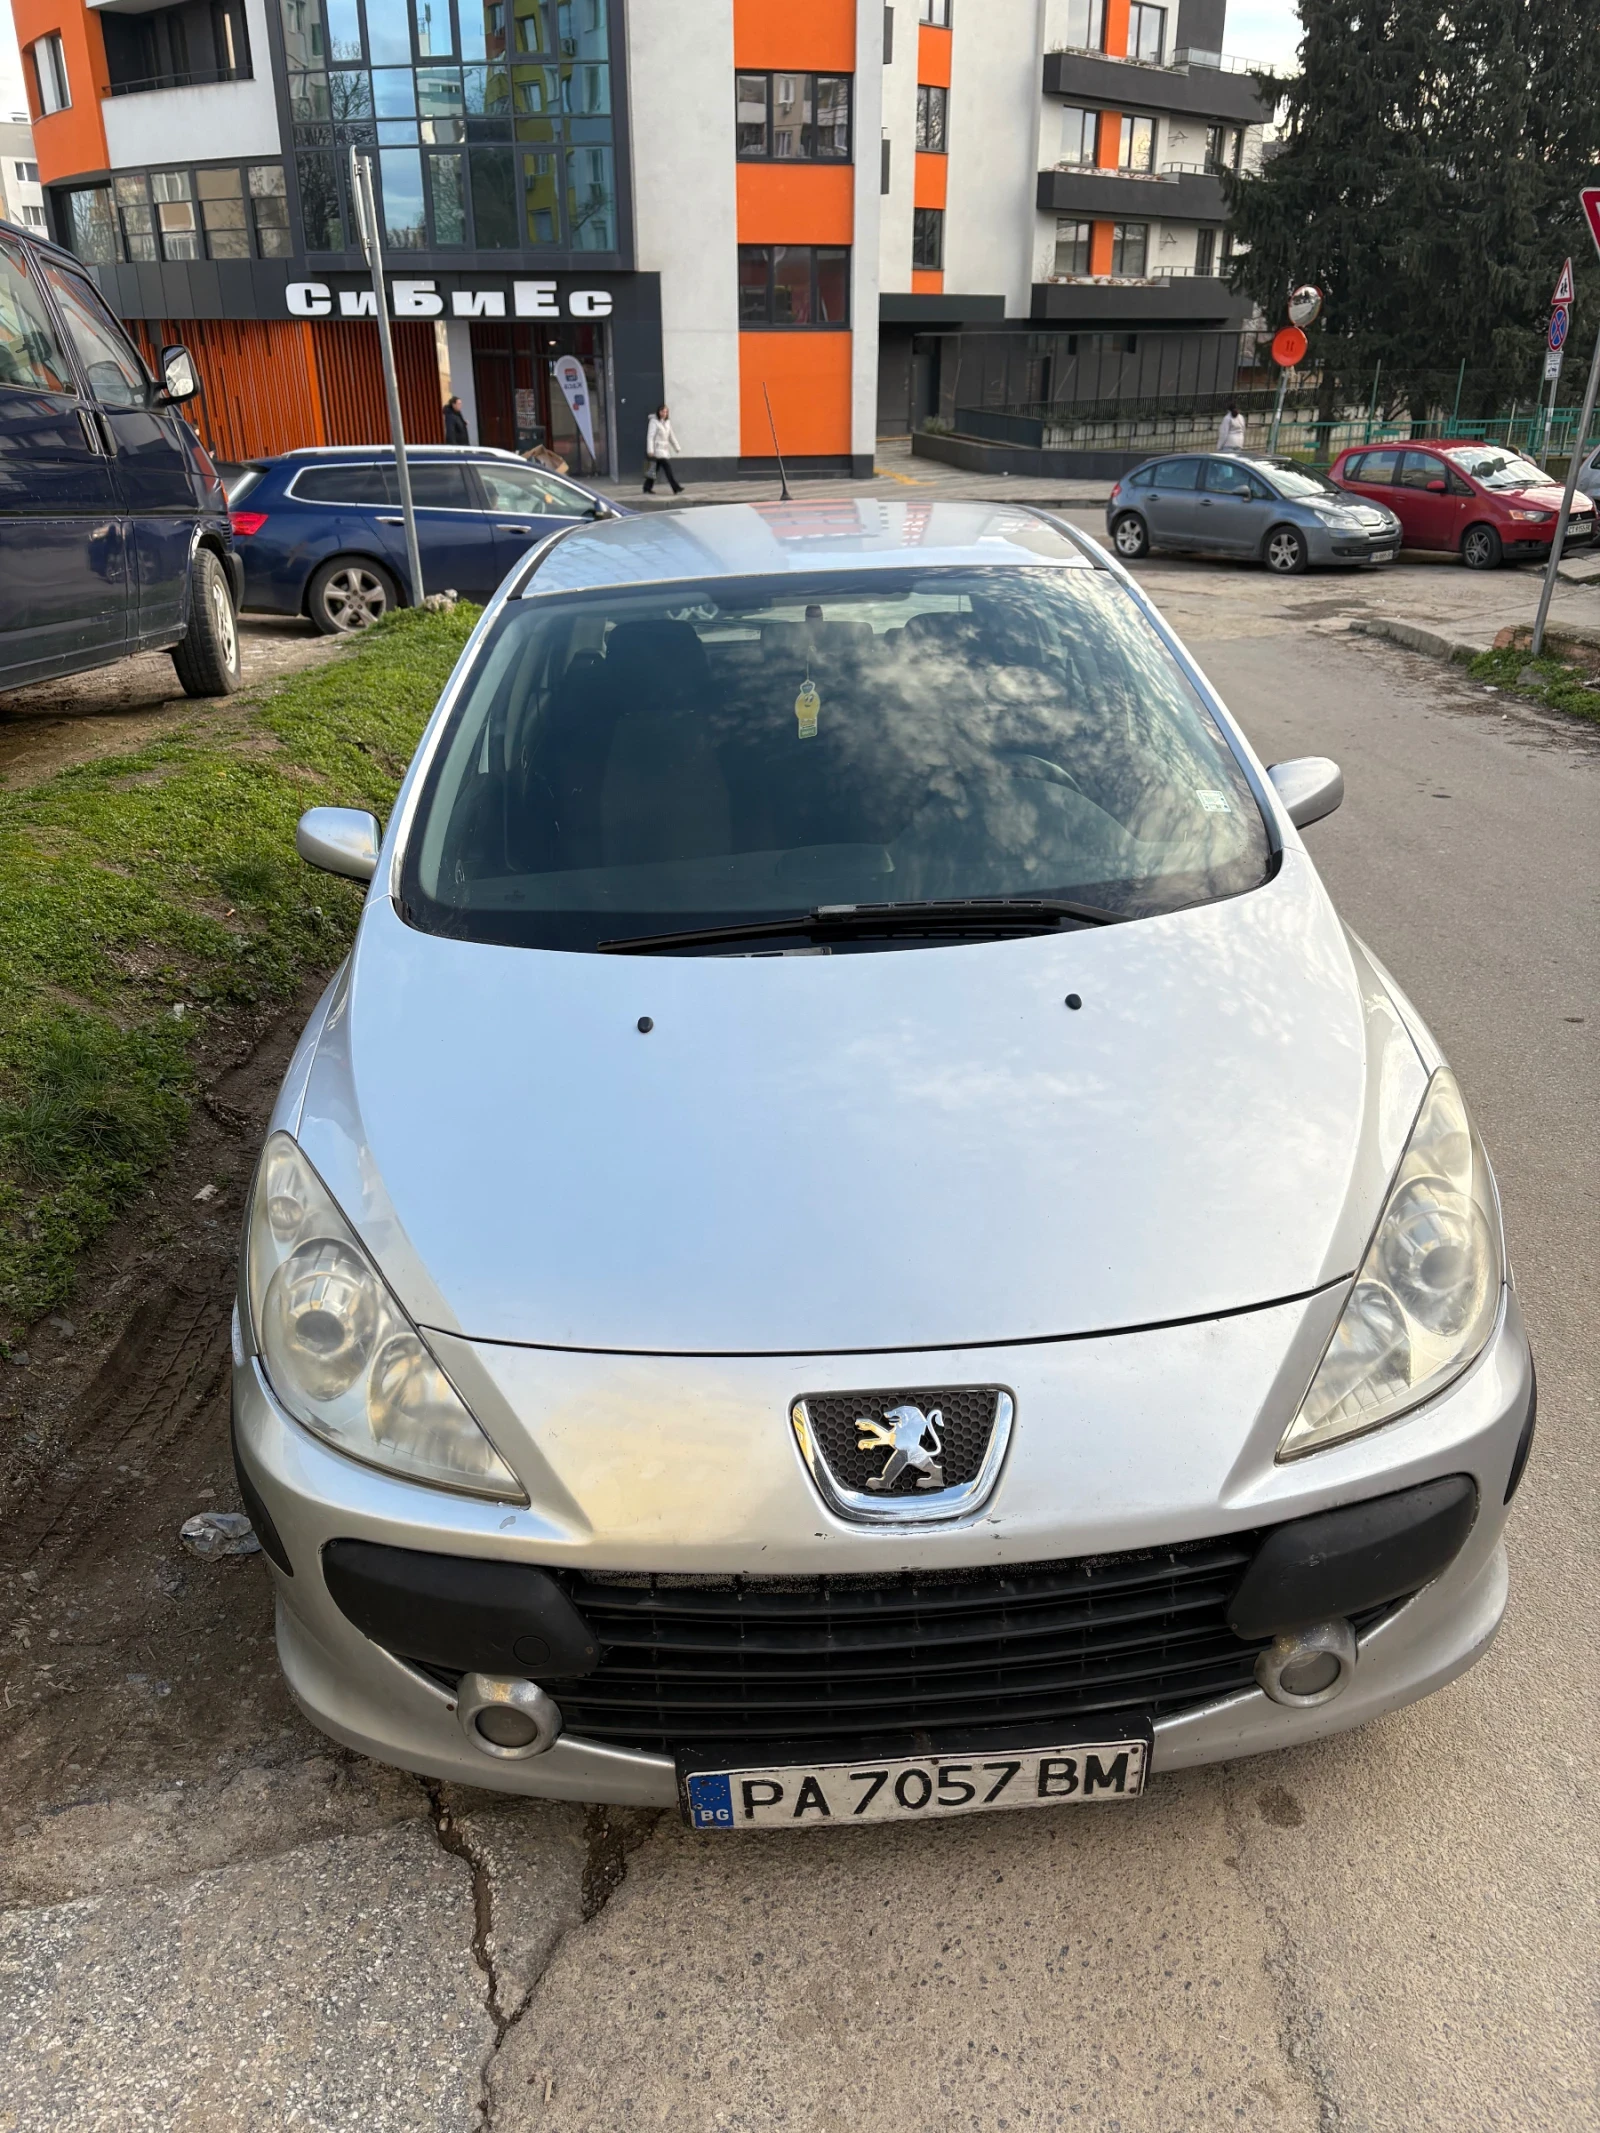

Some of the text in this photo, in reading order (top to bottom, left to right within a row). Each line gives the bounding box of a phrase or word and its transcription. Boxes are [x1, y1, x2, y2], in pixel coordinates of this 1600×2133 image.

[285, 280, 613, 317] СиБиЕс
[741, 1752, 1130, 1819] PA 7057 BM
[701, 1809, 729, 1821] BG
